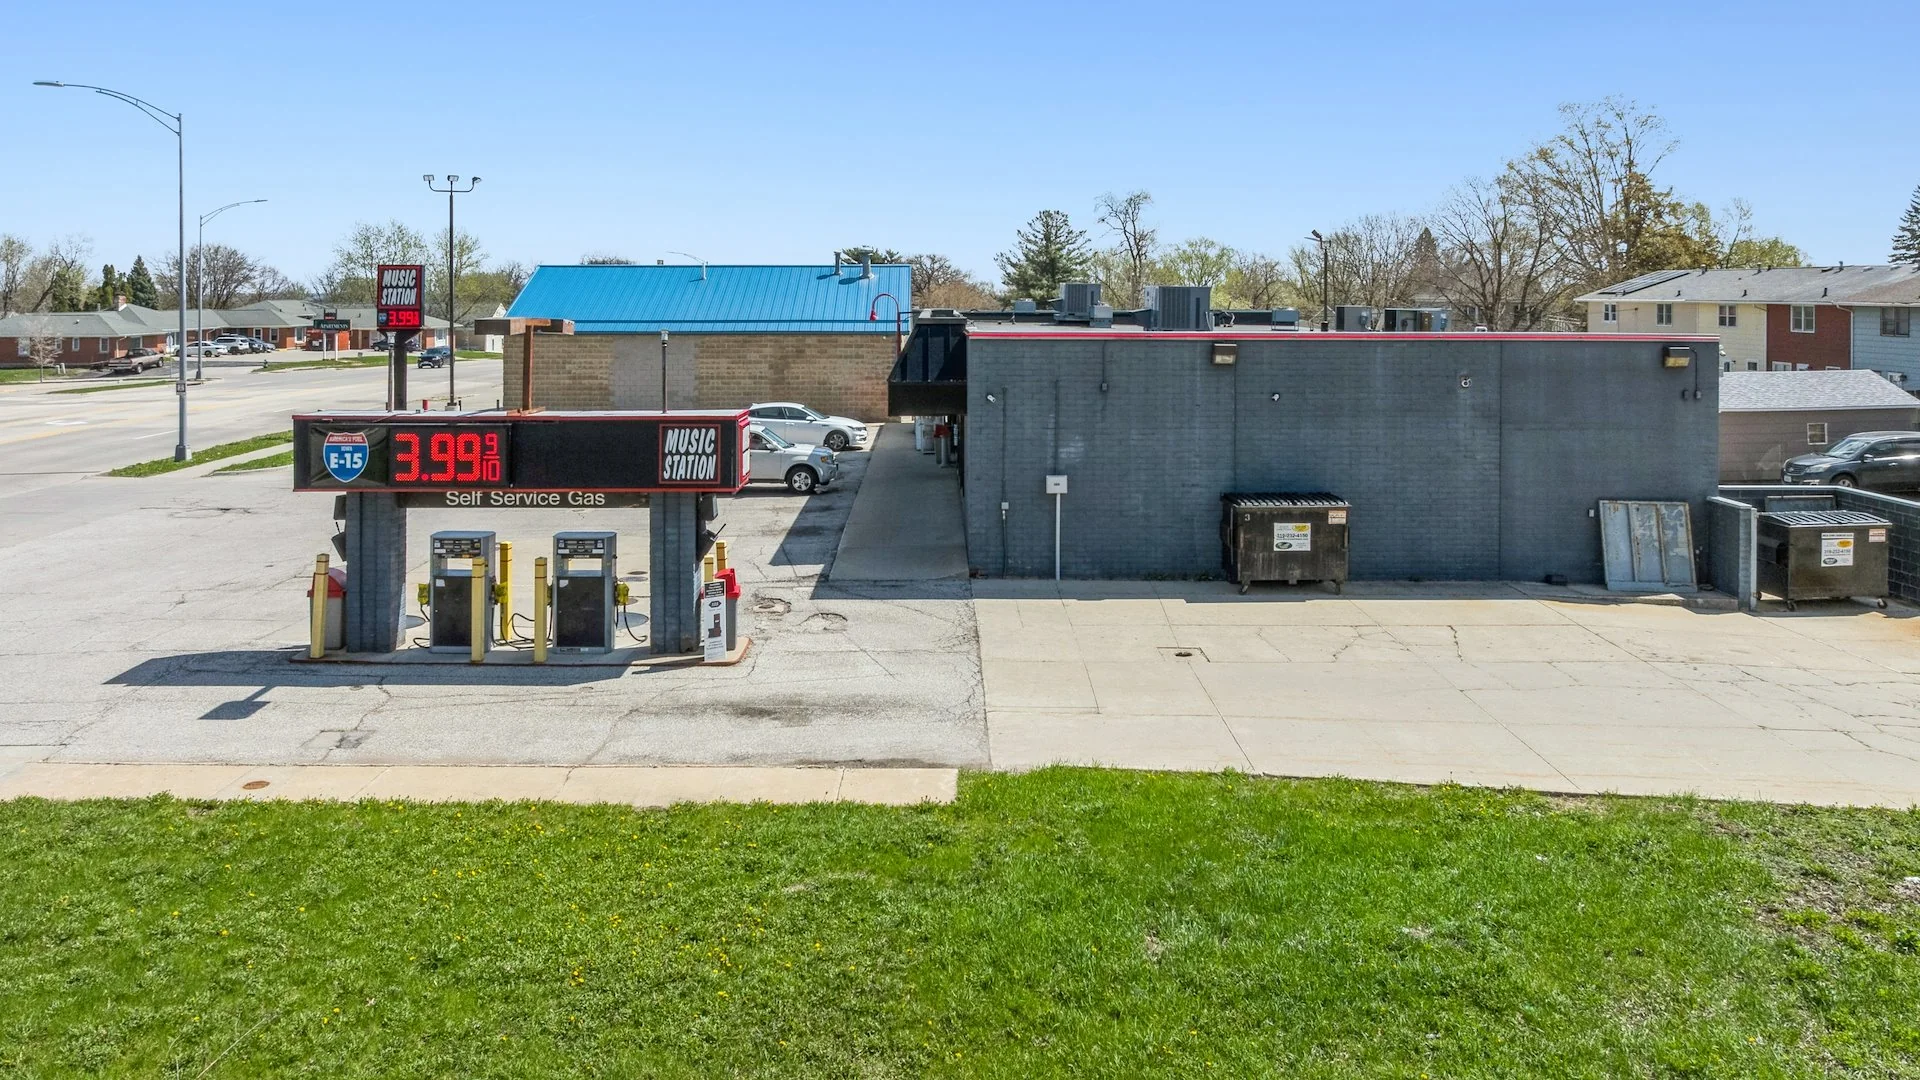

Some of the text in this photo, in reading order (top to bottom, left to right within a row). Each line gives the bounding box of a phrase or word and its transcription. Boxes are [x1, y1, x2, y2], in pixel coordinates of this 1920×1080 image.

[382, 269, 417, 287] MUSIC
[381, 288, 417, 305] STATION
[664, 428, 716, 454] MUSIC
[329, 452, 363, 469] E-15
[395, 433, 481, 481] 3.99
[663, 454, 717, 480] STATION
[446, 491, 605, 506] Self Service Gas
[1244, 513, 1251, 521] 3
